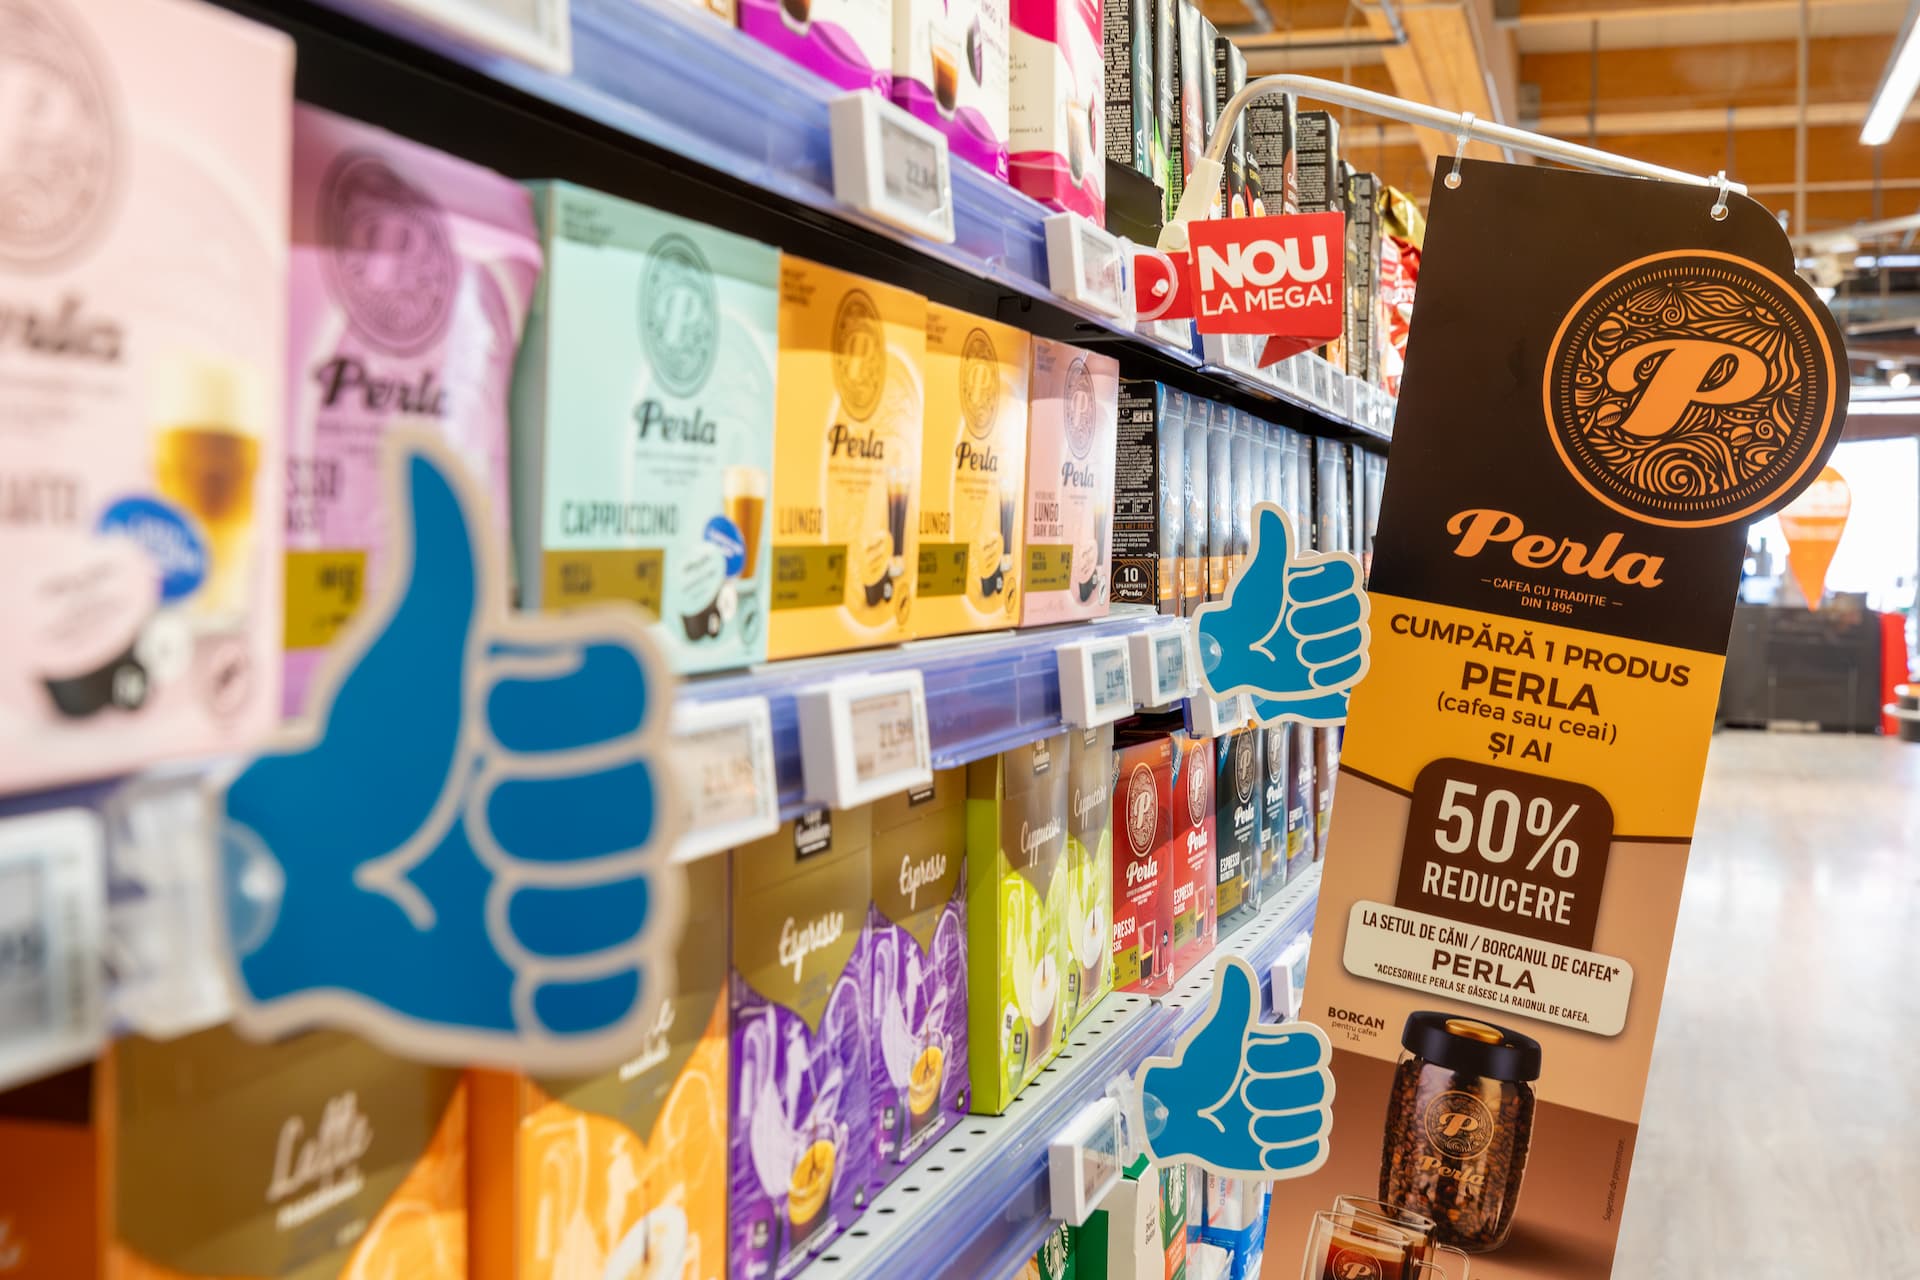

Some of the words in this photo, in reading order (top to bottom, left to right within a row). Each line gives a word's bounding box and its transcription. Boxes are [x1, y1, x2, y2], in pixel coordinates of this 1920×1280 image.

[1197, 235, 1328, 291] NOU
[1201, 293, 1238, 316] LA
[1246, 283, 1332, 313] MEGA!
[633, 398, 719, 446] Perla
[828, 424, 885, 461] Perla
[955, 441, 998, 472] Perla
[1061, 462, 1095, 489] Perla
[560, 500, 679, 538] CAPPUCCINO
[778, 506, 823, 535] LUNGO
[919, 510, 951, 534] LUNGO
[1033, 502, 1060, 523] LUNGO
[1446, 508, 1664, 588] Perla
[1124, 568, 1138, 582] 10
[1494, 577, 1530, 595] CAFEA
[1533, 583, 1550, 597] CU
[1120, 590, 1142, 598] Perla
[1520, 596, 1542, 609] DIN
[1544, 600, 1574, 614] 1895
[1390, 613, 1535, 660] CUMPĂRĂ
[1544, 640, 1556, 662] 1
[1564, 644, 1691, 687] PRODUS
[1460, 661, 1600, 716] PERLA
[1437, 691, 1506, 722] (cafea
[1512, 709, 1552, 730] sau
[1558, 719, 1618, 746] ceai)
[1488, 732, 1515, 760] ȘI
[1520, 738, 1552, 763] AI
[1234, 803, 1254, 829] Perla
[1434, 778, 1580, 878] 50%
[1187, 826, 1208, 856] Perla
[1126, 856, 1158, 888] Perla
[1220, 852, 1240, 874] ESPRESSO
[899, 852, 947, 909] Espresso
[1174, 880, 1194, 906] ESPRESSO
[1422, 861, 1575, 926] REDUCERE
[1113, 916, 1136, 941] PRESSO
[1362, 910, 1377, 926] LA
[1380, 914, 1416, 938] SETUL
[1419, 923, 1436, 942] DE
[1438, 926, 1468, 950] CĂNI
[1470, 935, 1480, 951] /
[1482, 938, 1548, 968] BORCANUL
[1551, 954, 1569, 972] DE
[778, 910, 844, 983] Espresso
[1432, 949, 1536, 994] PERLA
[1429, 974, 1454, 992] PERLA
[1456, 980, 1466, 994] SE
[1468, 982, 1498, 1002] GĂSESC
[1500, 992, 1510, 1004] LA
[1512, 994, 1546, 1013] RAIONUL
[1549, 1004, 1560, 1016] DE
[1562, 1007, 1590, 1024] CAFEA.
[1328, 1006, 1386, 1030] BORCAN
[1332, 1020, 1356, 1034] pentru
[1357, 1024, 1378, 1038] cafea
[1419, 1154, 1486, 1188] Perla
